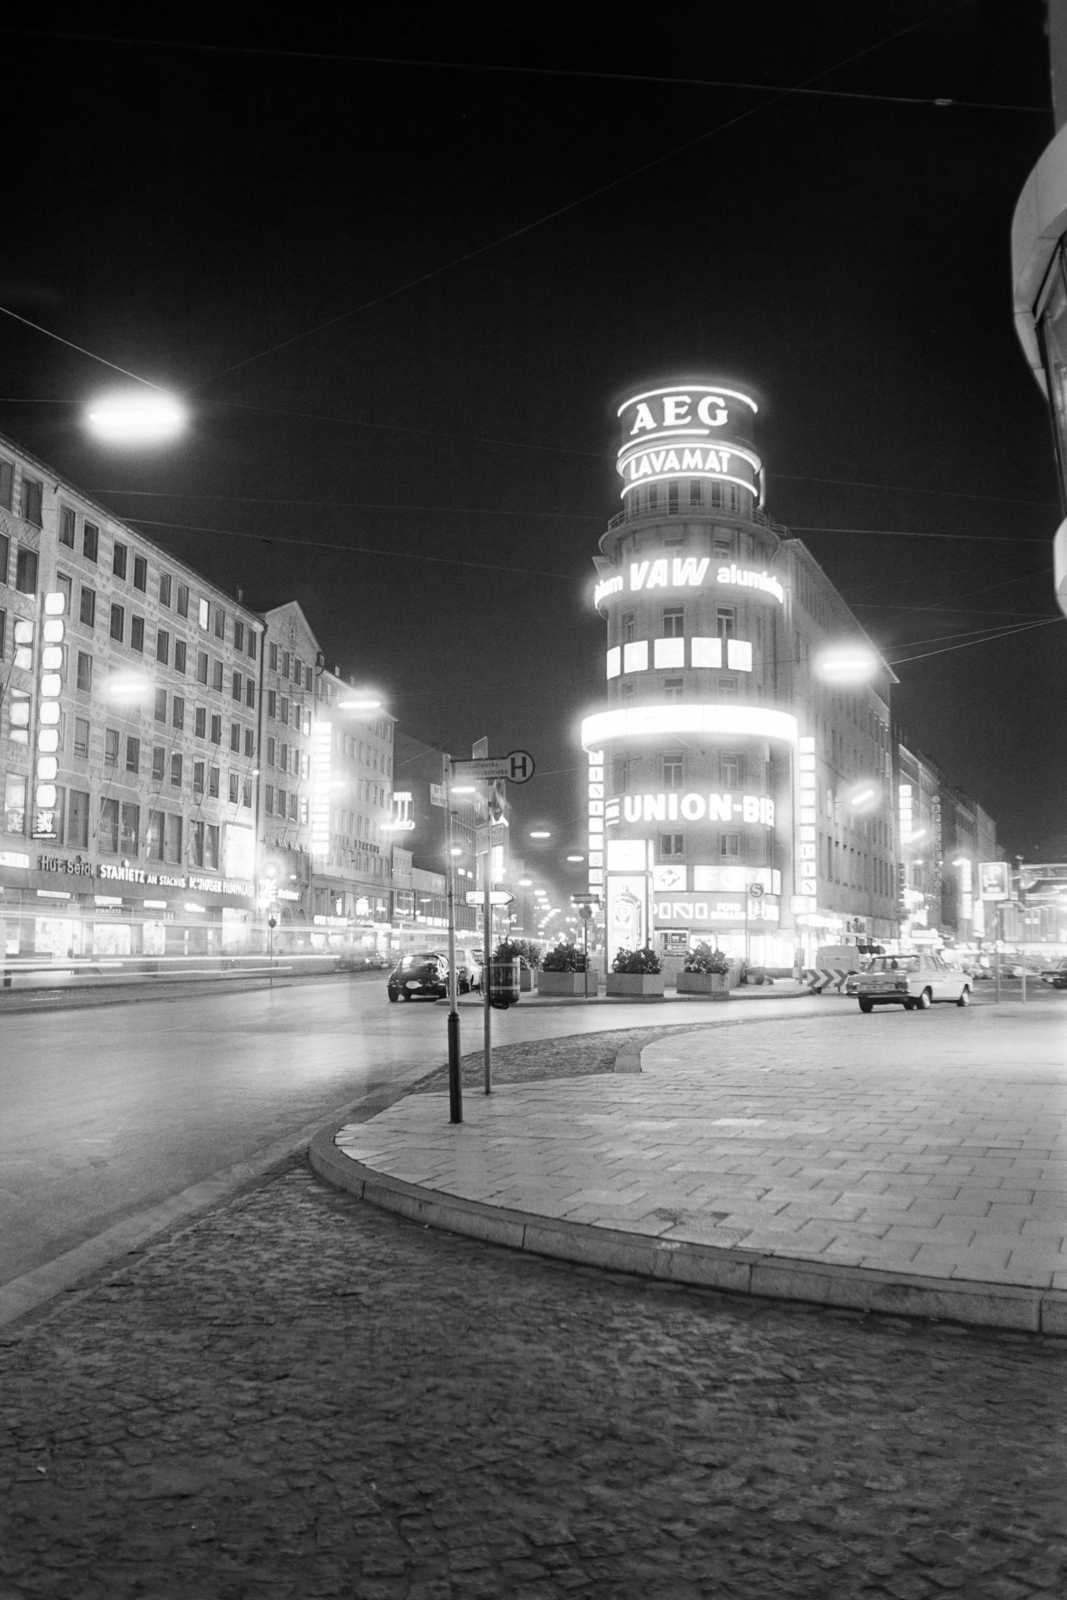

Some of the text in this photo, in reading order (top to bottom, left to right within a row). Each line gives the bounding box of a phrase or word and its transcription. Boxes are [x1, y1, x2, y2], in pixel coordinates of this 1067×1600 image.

[630, 396, 728, 435] AEG
[630, 449, 730, 480] LAVAMAT
[630, 557, 709, 591] VAW
[510, 757, 526, 777] H
[147, 874, 157, 885] AM
[160, 876, 186, 888] STACHUS
